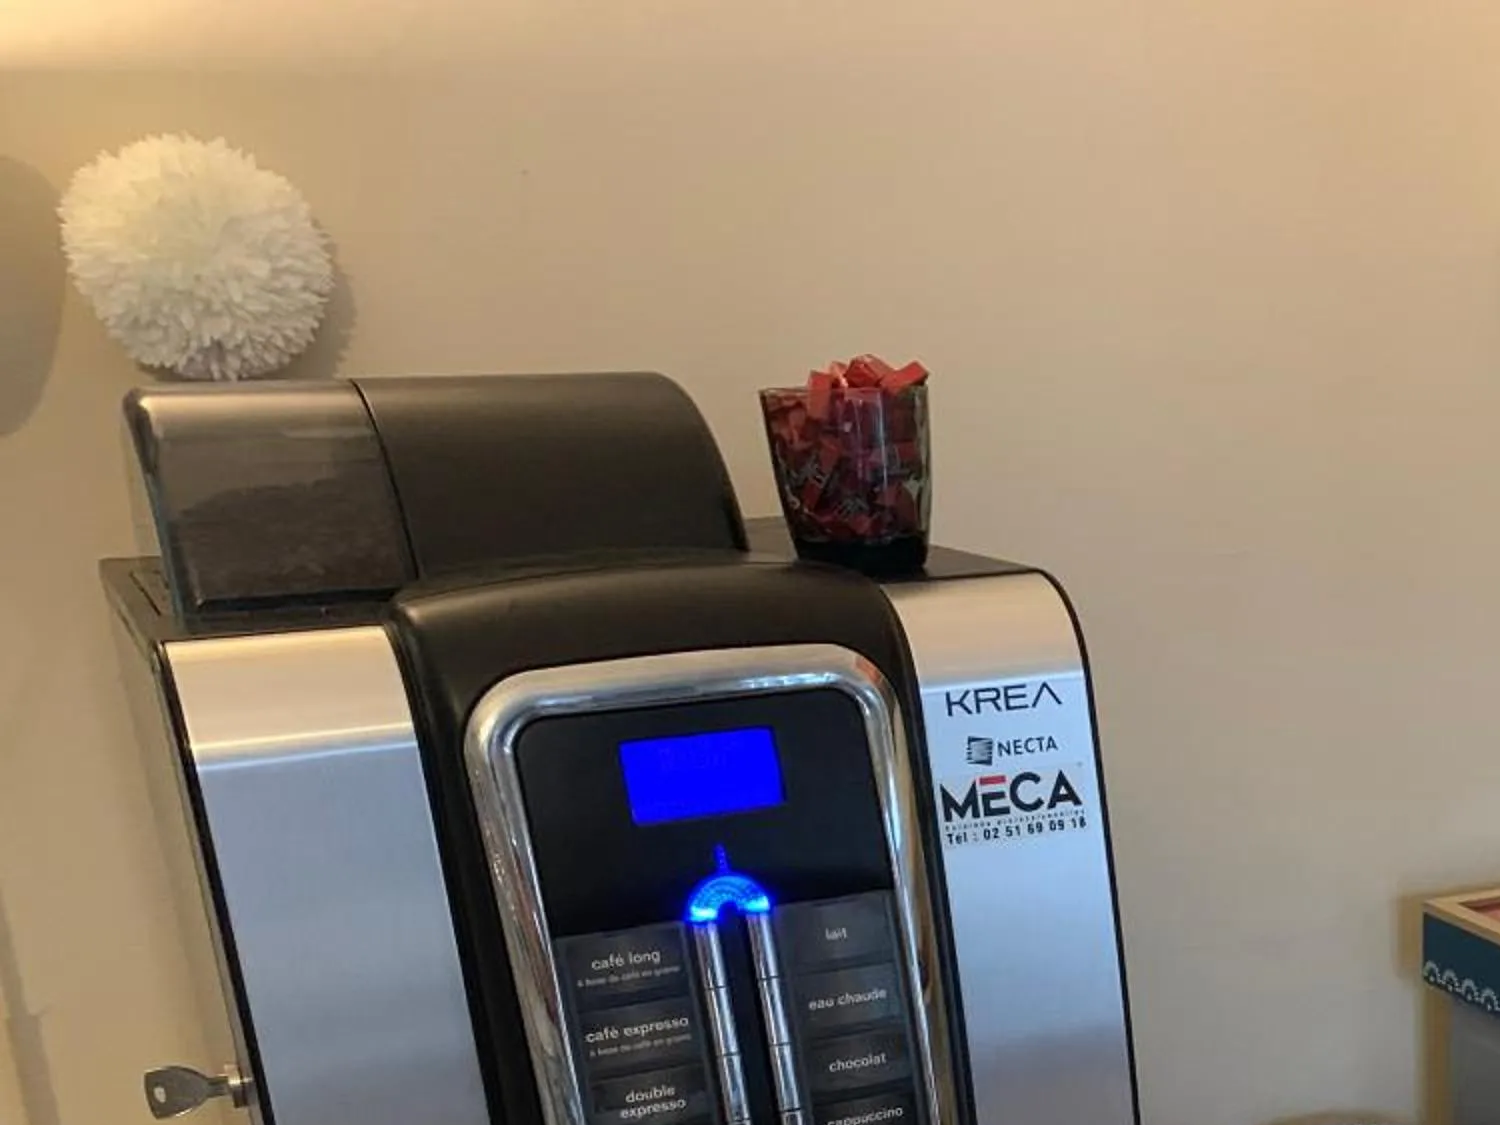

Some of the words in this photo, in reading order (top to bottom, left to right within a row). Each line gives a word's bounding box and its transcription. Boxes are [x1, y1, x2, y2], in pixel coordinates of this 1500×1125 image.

[946, 681, 1062, 716] KREA
[997, 735, 1059, 757] NECTA
[940, 770, 1083, 823] MECA
[983, 827, 1000, 840] 02
[1005, 825, 1021, 837] 51
[591, 952, 624, 971] café
[628, 951, 660, 965] long
[809, 998, 835, 1011] eau
[837, 988, 887, 1005] chaude
[585, 1025, 620, 1043] café
[623, 1017, 689, 1037] expresso
[829, 1052, 887, 1073] chocolat
[625, 1084, 676, 1103] double
[620, 1098, 687, 1120] expresso
